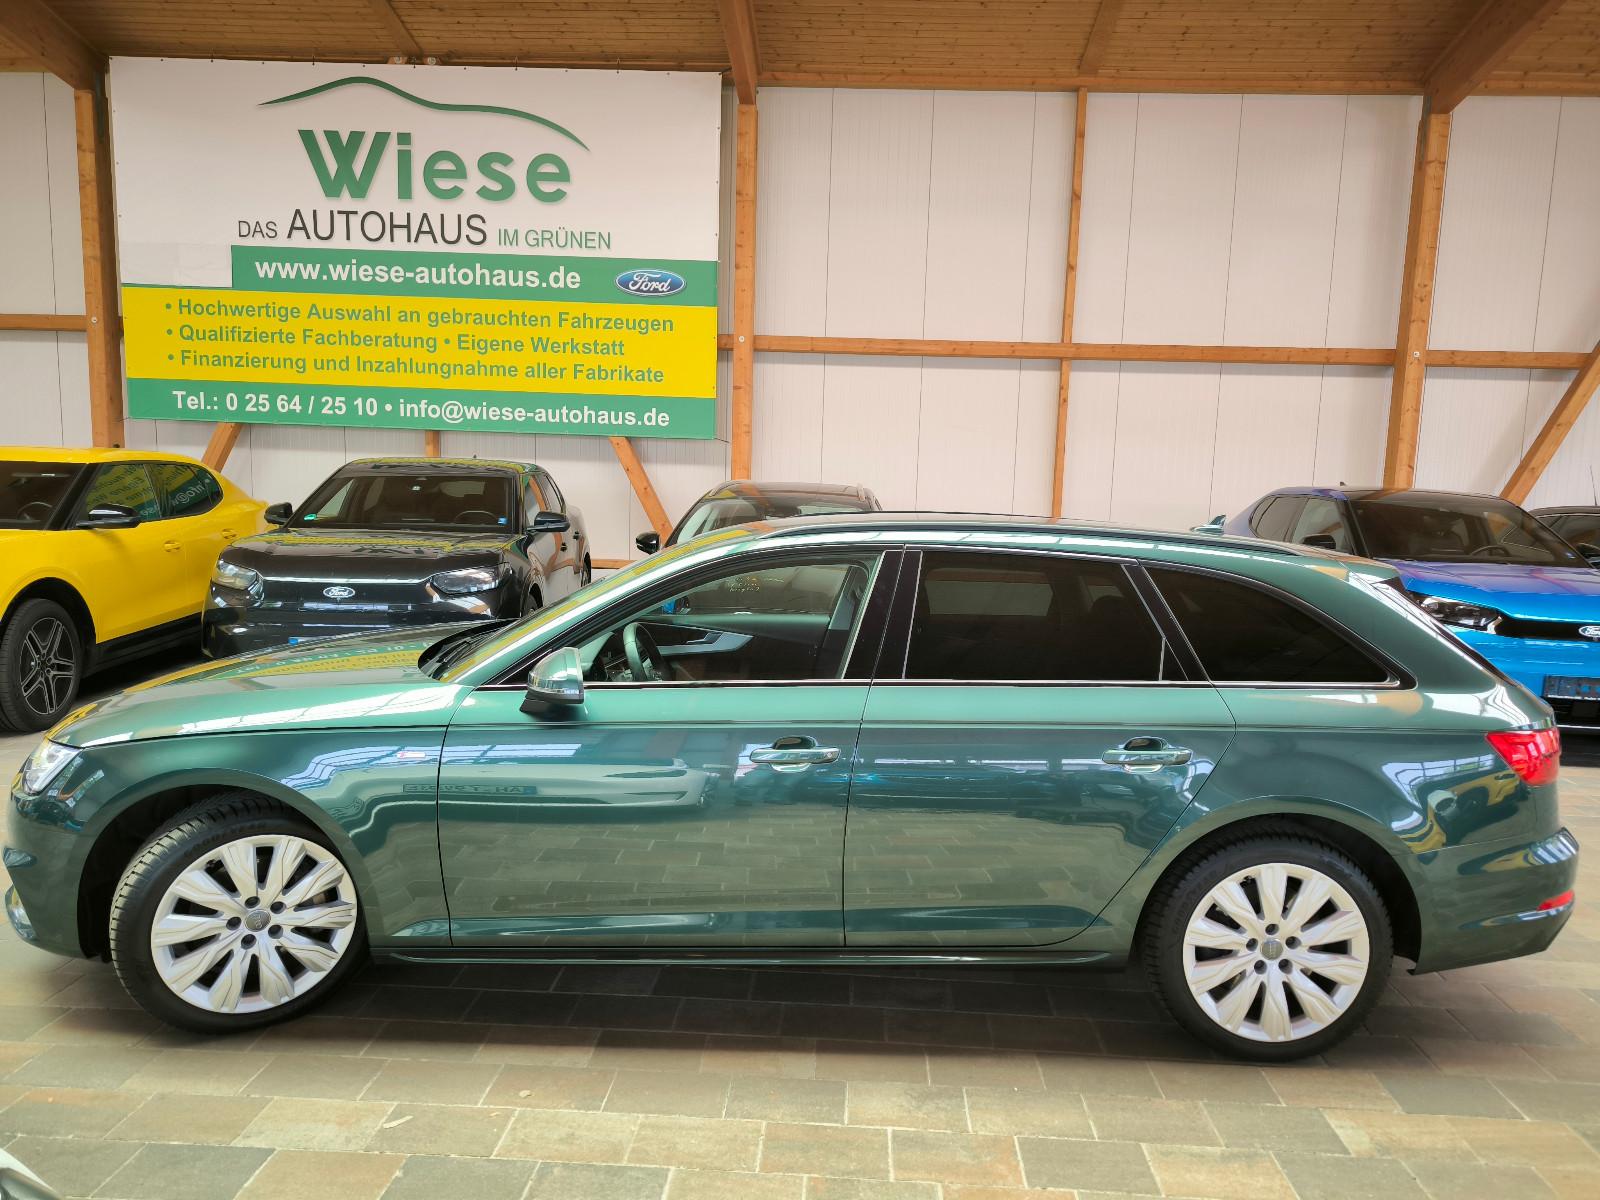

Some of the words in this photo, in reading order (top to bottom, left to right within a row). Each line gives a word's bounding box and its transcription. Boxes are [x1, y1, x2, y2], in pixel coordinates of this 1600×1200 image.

[298, 129, 571, 203] Wiese
[237, 220, 278, 239] DAS
[287, 208, 488, 246] AUTOHAUS
[498, 228, 519, 247] IM
[524, 226, 611, 250] GRÜNEN
[254, 258, 582, 289] www.wiese-autohaus.de
[628, 272, 671, 292] Ford
[178, 299, 301, 322] Hochwertige
[307, 303, 391, 322] Auswahl
[398, 311, 421, 323] an
[427, 308, 552, 327] gebrauchten
[558, 311, 674, 335] Fahrzeugen
[179, 324, 296, 344] Qualifizierte
[303, 328, 438, 353] Fachberatung
[457, 334, 525, 355] Eigene
[530, 336, 625, 356] Werkstatt
[181, 350, 307, 374] Finanzierung
[313, 354, 350, 372] und
[357, 356, 518, 380] Inzahlungnahme
[525, 362, 567, 379] aller
[573, 363, 664, 383] Fabrikate
[172, 390, 218, 411] Tel.:
[225, 393, 238, 411] 0
[245, 394, 270, 412] 25
[277, 395, 302, 413] 64
[308, 396, 315, 414] /
[321, 397, 347, 415] 25
[354, 398, 378, 416] 10
[400, 399, 670, 427] info@wiese-autohaus.de
